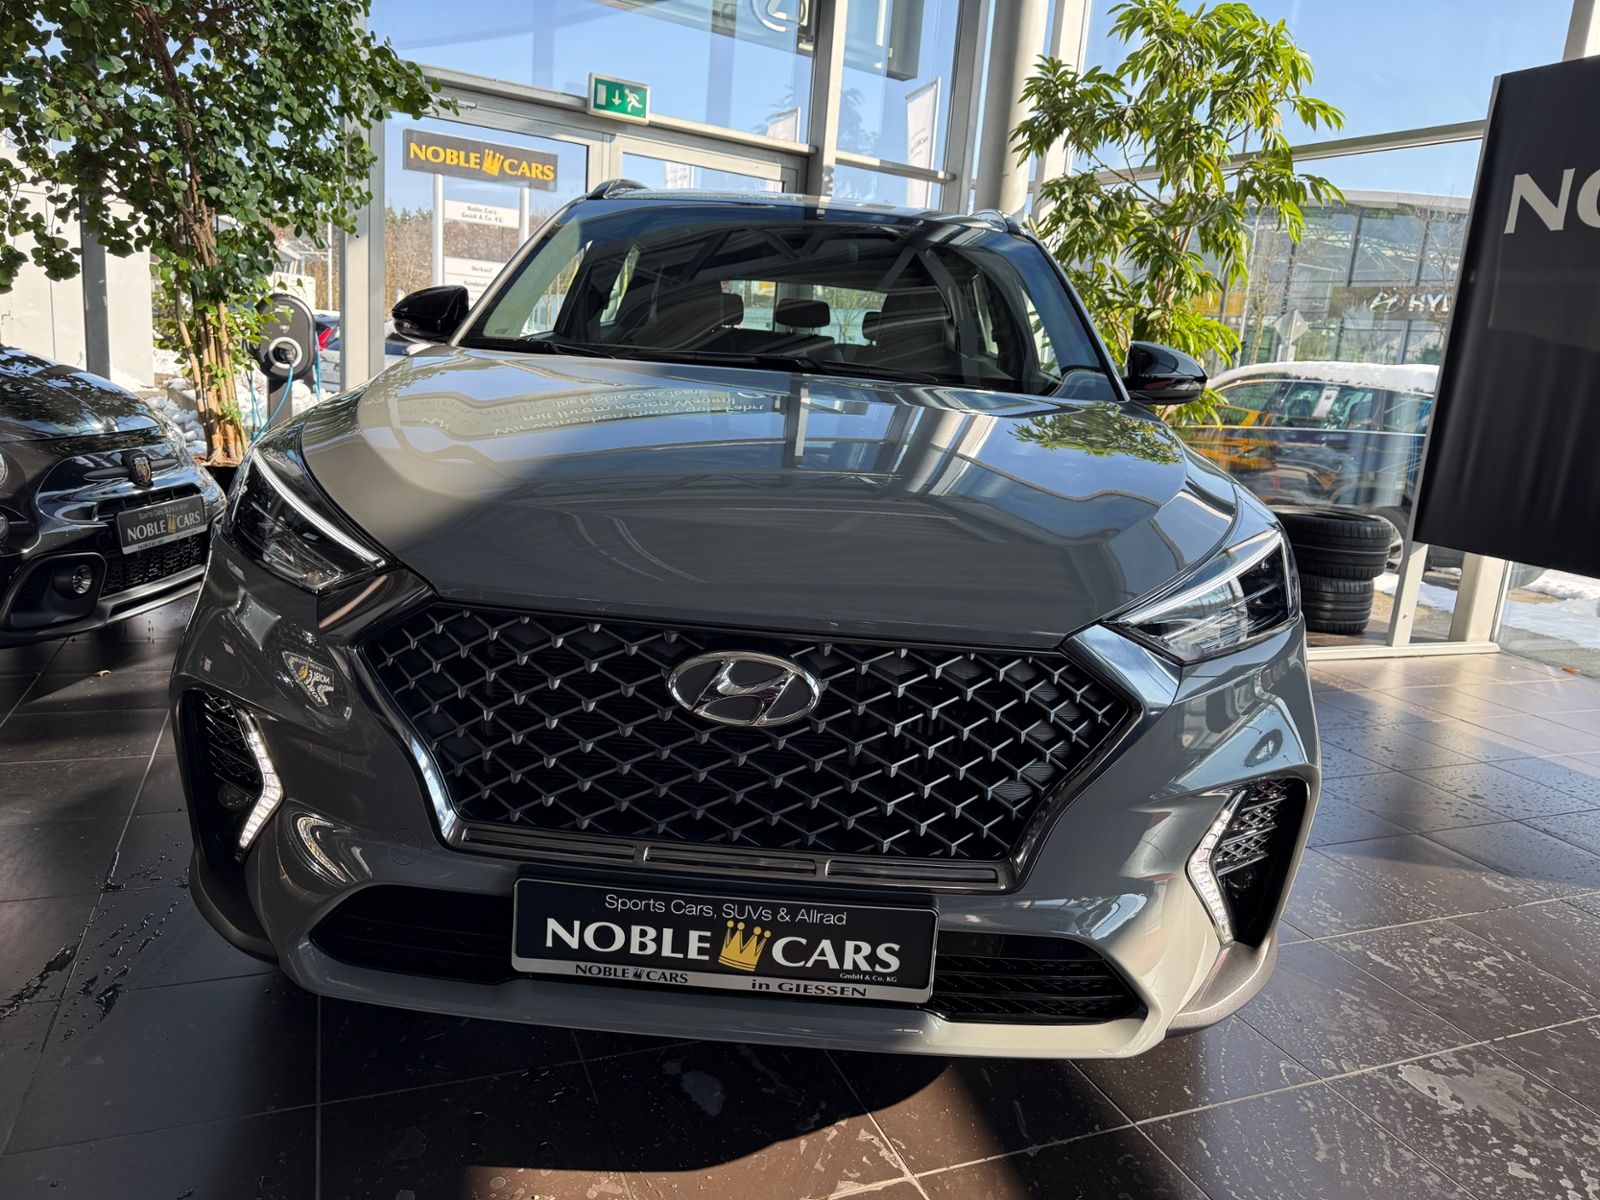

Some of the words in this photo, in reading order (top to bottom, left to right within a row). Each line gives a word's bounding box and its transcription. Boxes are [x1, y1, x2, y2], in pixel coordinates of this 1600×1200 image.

[409, 142, 481, 169] NOBLE
[503, 158, 555, 181] CARS
[127, 519, 167, 542] NOBLE
[176, 511, 201, 529] CARS
[605, 893, 666, 912] Sports
[671, 899, 718, 920] Cars,
[722, 903, 772, 921] SUVs
[777, 907, 791, 922] &
[795, 908, 847, 926] Allrad
[545, 917, 712, 961] NOBLE
[771, 936, 901, 974] CARS
[575, 964, 630, 979] NOBLE
[646, 970, 688, 984] CARS
[751, 978, 770, 991] in
[777, 981, 867, 997] GIESSEN
[839, 972, 864, 981] GmbH
[864, 974, 871, 982] &
[872, 974, 885, 982] Co.
[886, 975, 897, 983] KG
